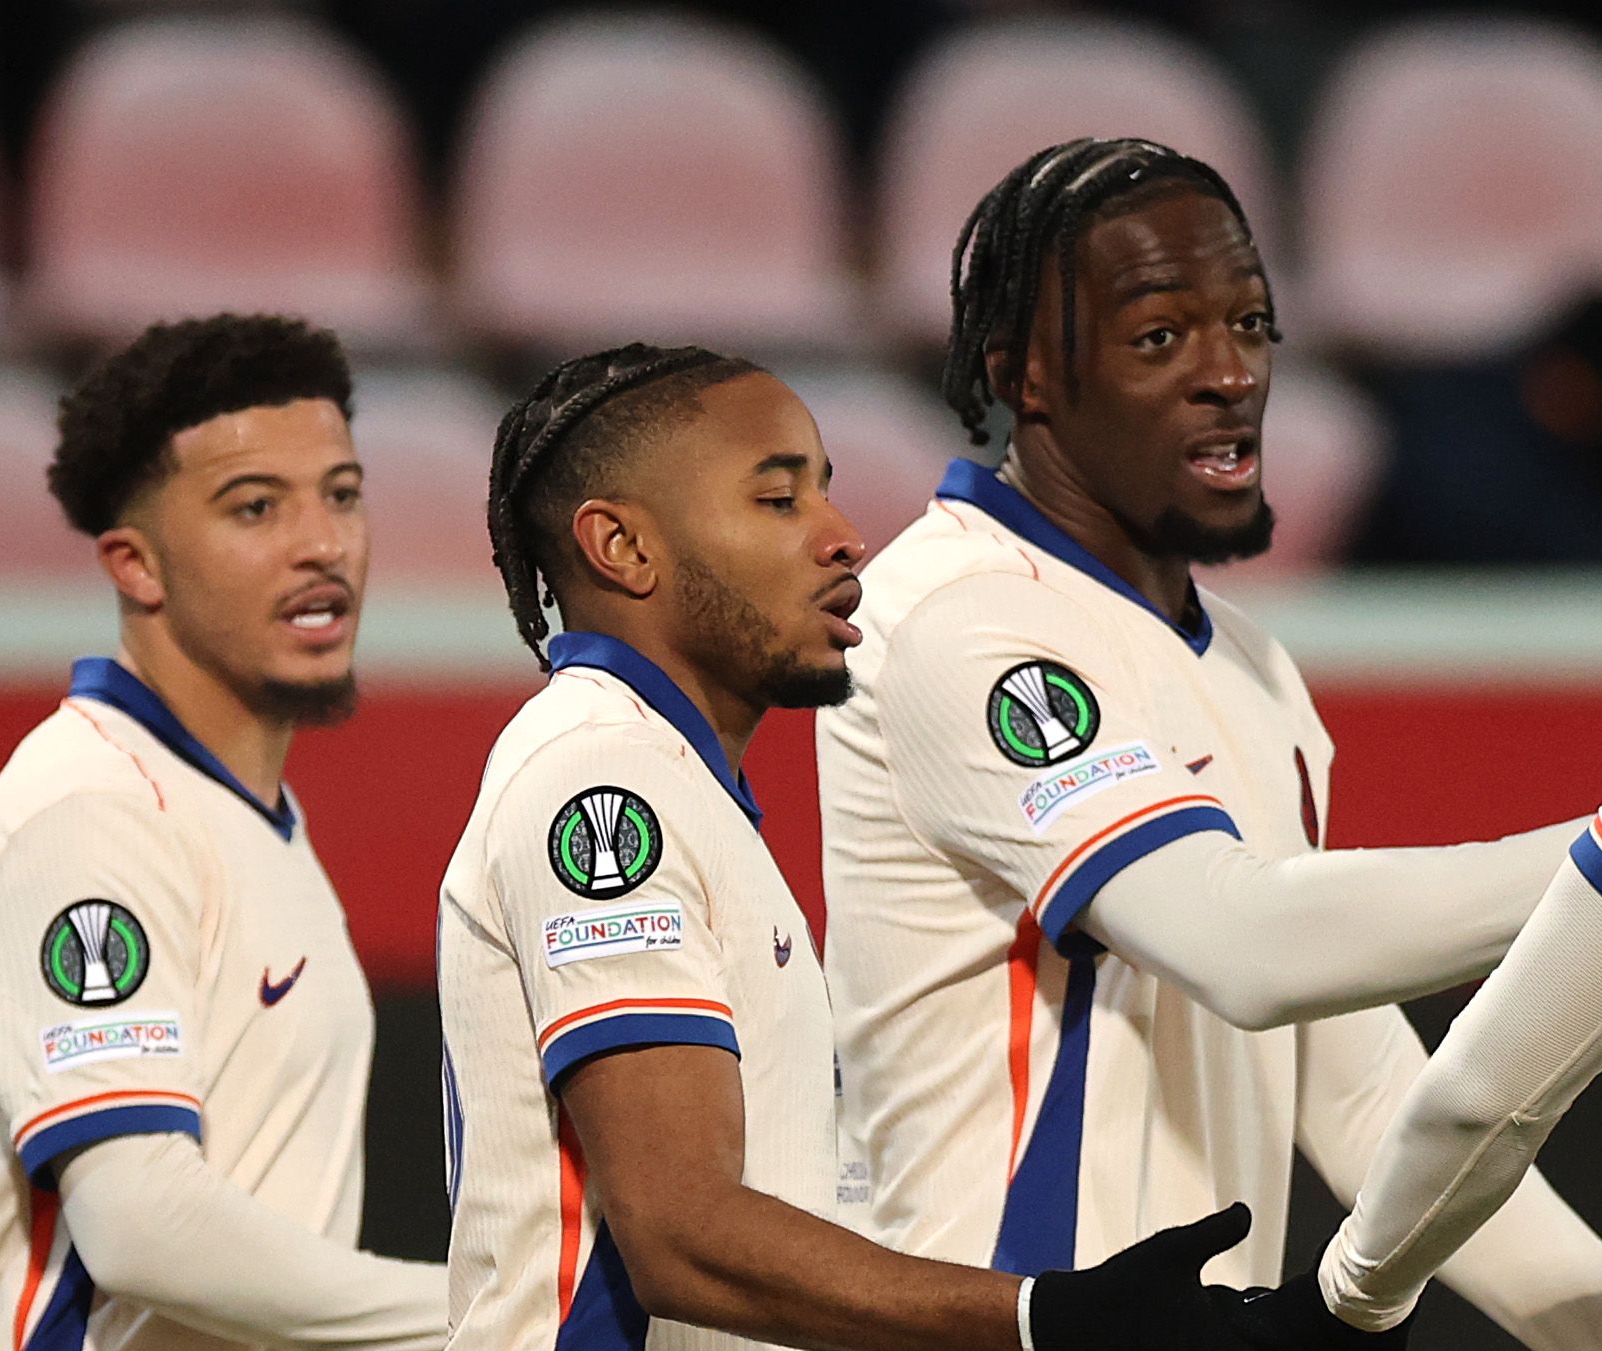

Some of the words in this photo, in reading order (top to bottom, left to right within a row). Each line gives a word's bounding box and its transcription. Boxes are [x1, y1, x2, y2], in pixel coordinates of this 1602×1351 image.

[1026, 749, 1151, 820] FOUNDATION
[545, 916, 575, 931] UEFA
[546, 915, 681, 948] FOUNDATION
[45, 1026, 178, 1055] FOUNDATION
